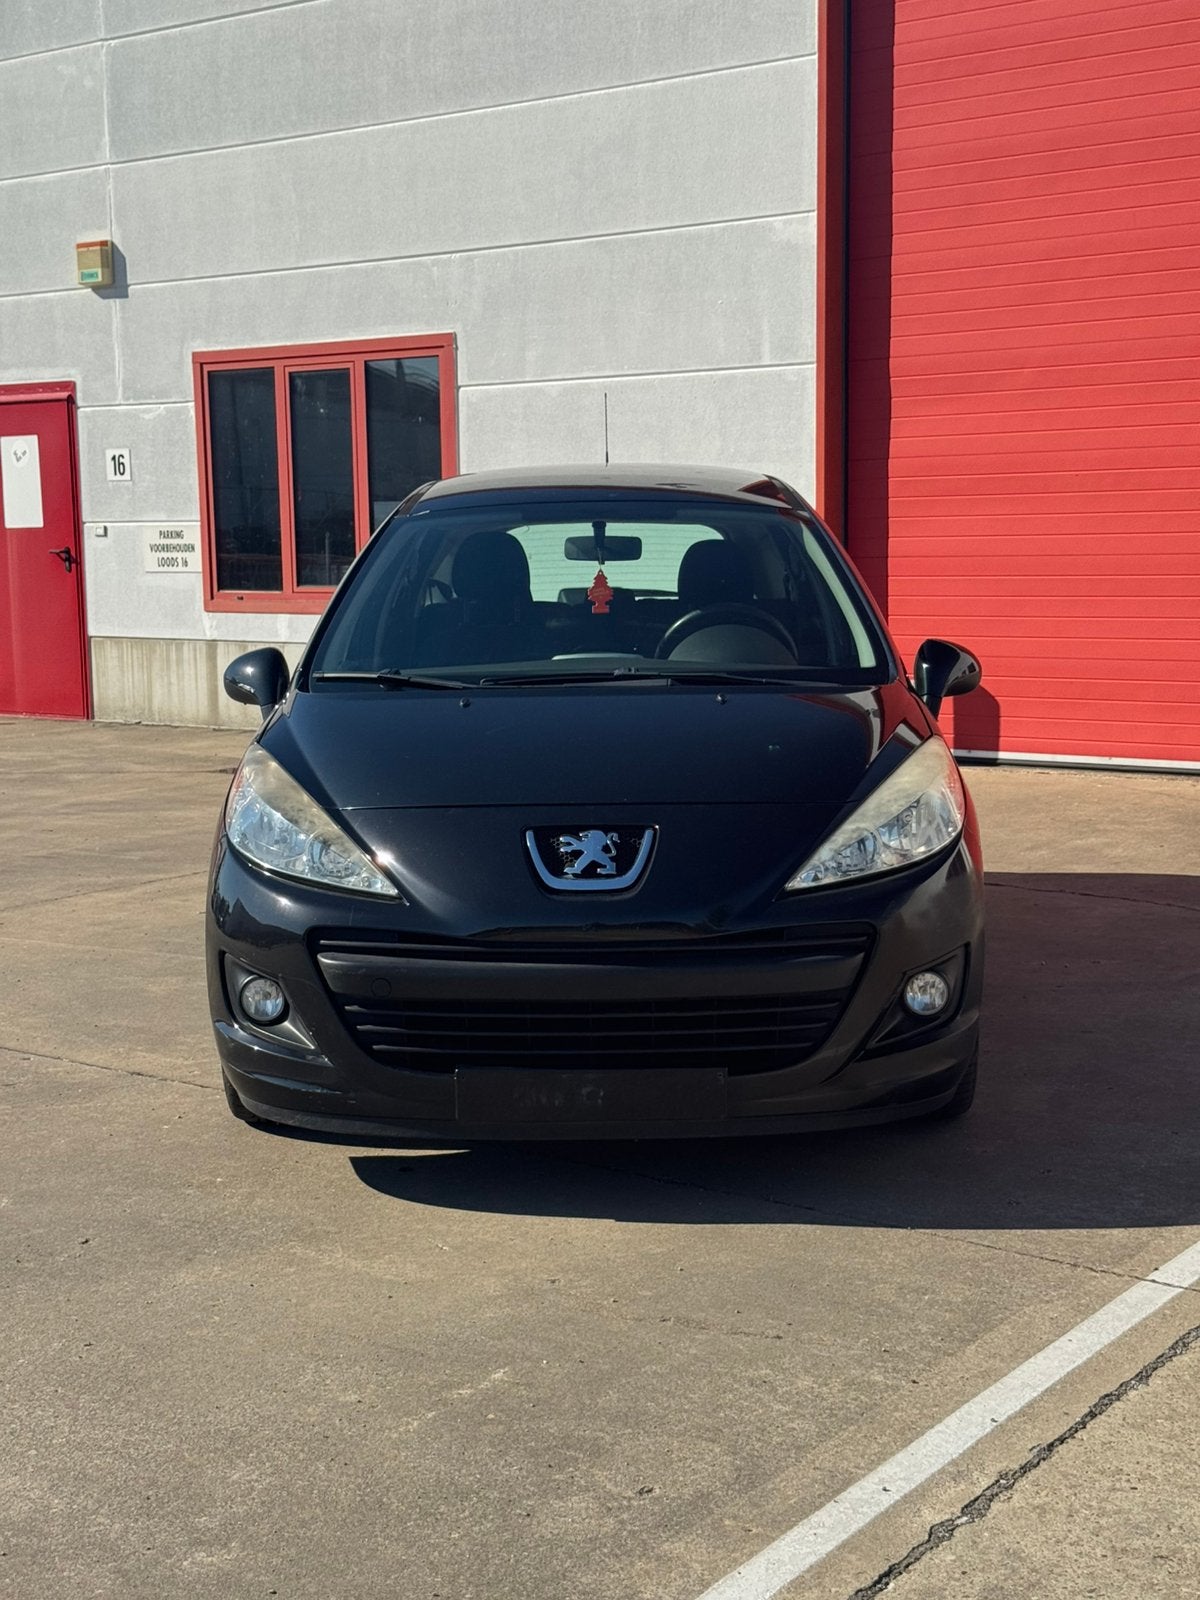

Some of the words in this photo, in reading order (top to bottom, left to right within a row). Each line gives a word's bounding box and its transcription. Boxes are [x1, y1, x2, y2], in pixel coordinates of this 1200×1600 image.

[111, 454, 126, 476] 16
[159, 530, 184, 539] PARKING
[149, 543, 195, 553] VOORBEHOUDEN
[157, 557, 179, 567] LOODS
[181, 557, 188, 567] 16
